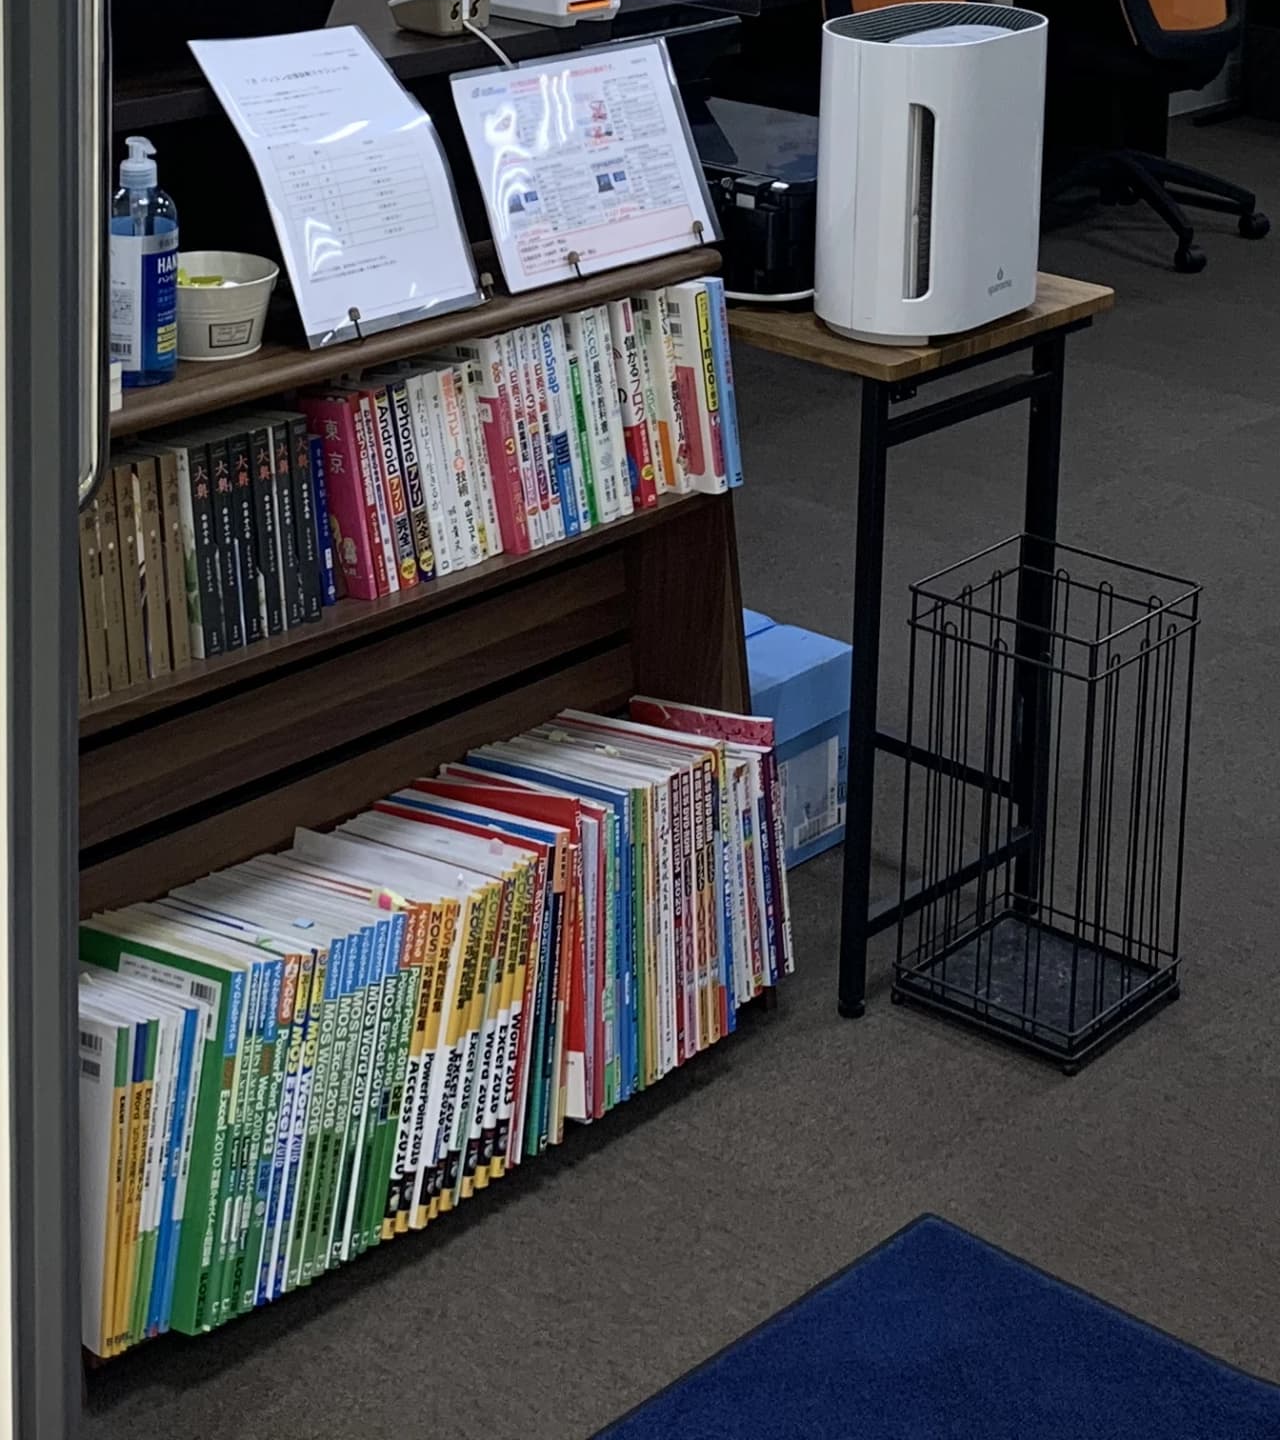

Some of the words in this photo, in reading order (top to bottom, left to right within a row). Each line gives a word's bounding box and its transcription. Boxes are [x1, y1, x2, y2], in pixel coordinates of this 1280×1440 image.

[537, 323, 562, 394] ScanSnap
[582, 315, 600, 360] Excel
[323, 419, 346, 475] 東京
[374, 404, 400, 475] Android
[394, 397, 418, 463] iPhone
[674, 878, 682, 915] 2020
[427, 910, 442, 953] MOS
[336, 997, 351, 1039] MOS
[348, 990, 364, 1031] MOS
[363, 984, 380, 1027] MOS
[381, 977, 396, 1019] MOS
[398, 967, 420, 1043] PowerPoint
[319, 1002, 334, 1042] MOS
[373, 1021, 389, 1066] Excel
[507, 1012, 522, 1056] Word
[267, 1028, 290, 1109] PowerPoint
[313, 1049, 329, 1093] Word
[328, 1040, 346, 1086] Excel
[337, 1032, 357, 1102] PowerPoint
[356, 1027, 374, 1075] Word
[383, 1052, 396, 1086] 2016
[394, 1048, 408, 1081] 2016
[465, 1031, 479, 1073] Excel
[254, 1074, 268, 1111] Word
[322, 1086, 339, 1129] 2016
[351, 1076, 367, 1117] 2016
[369, 1066, 384, 1108] 2016
[401, 1060, 420, 1125] Access
[414, 1051, 434, 1131] PowerPoint
[460, 1075, 473, 1109] 2016
[474, 1084, 488, 1125] 2016
[216, 1089, 229, 1130] Excel
[307, 1095, 324, 1136] 2016
[333, 1104, 348, 1133] 2016
[211, 1132, 224, 1166] 2010
[262, 1110, 278, 1155] 2013
[409, 1133, 423, 1165] 2016
